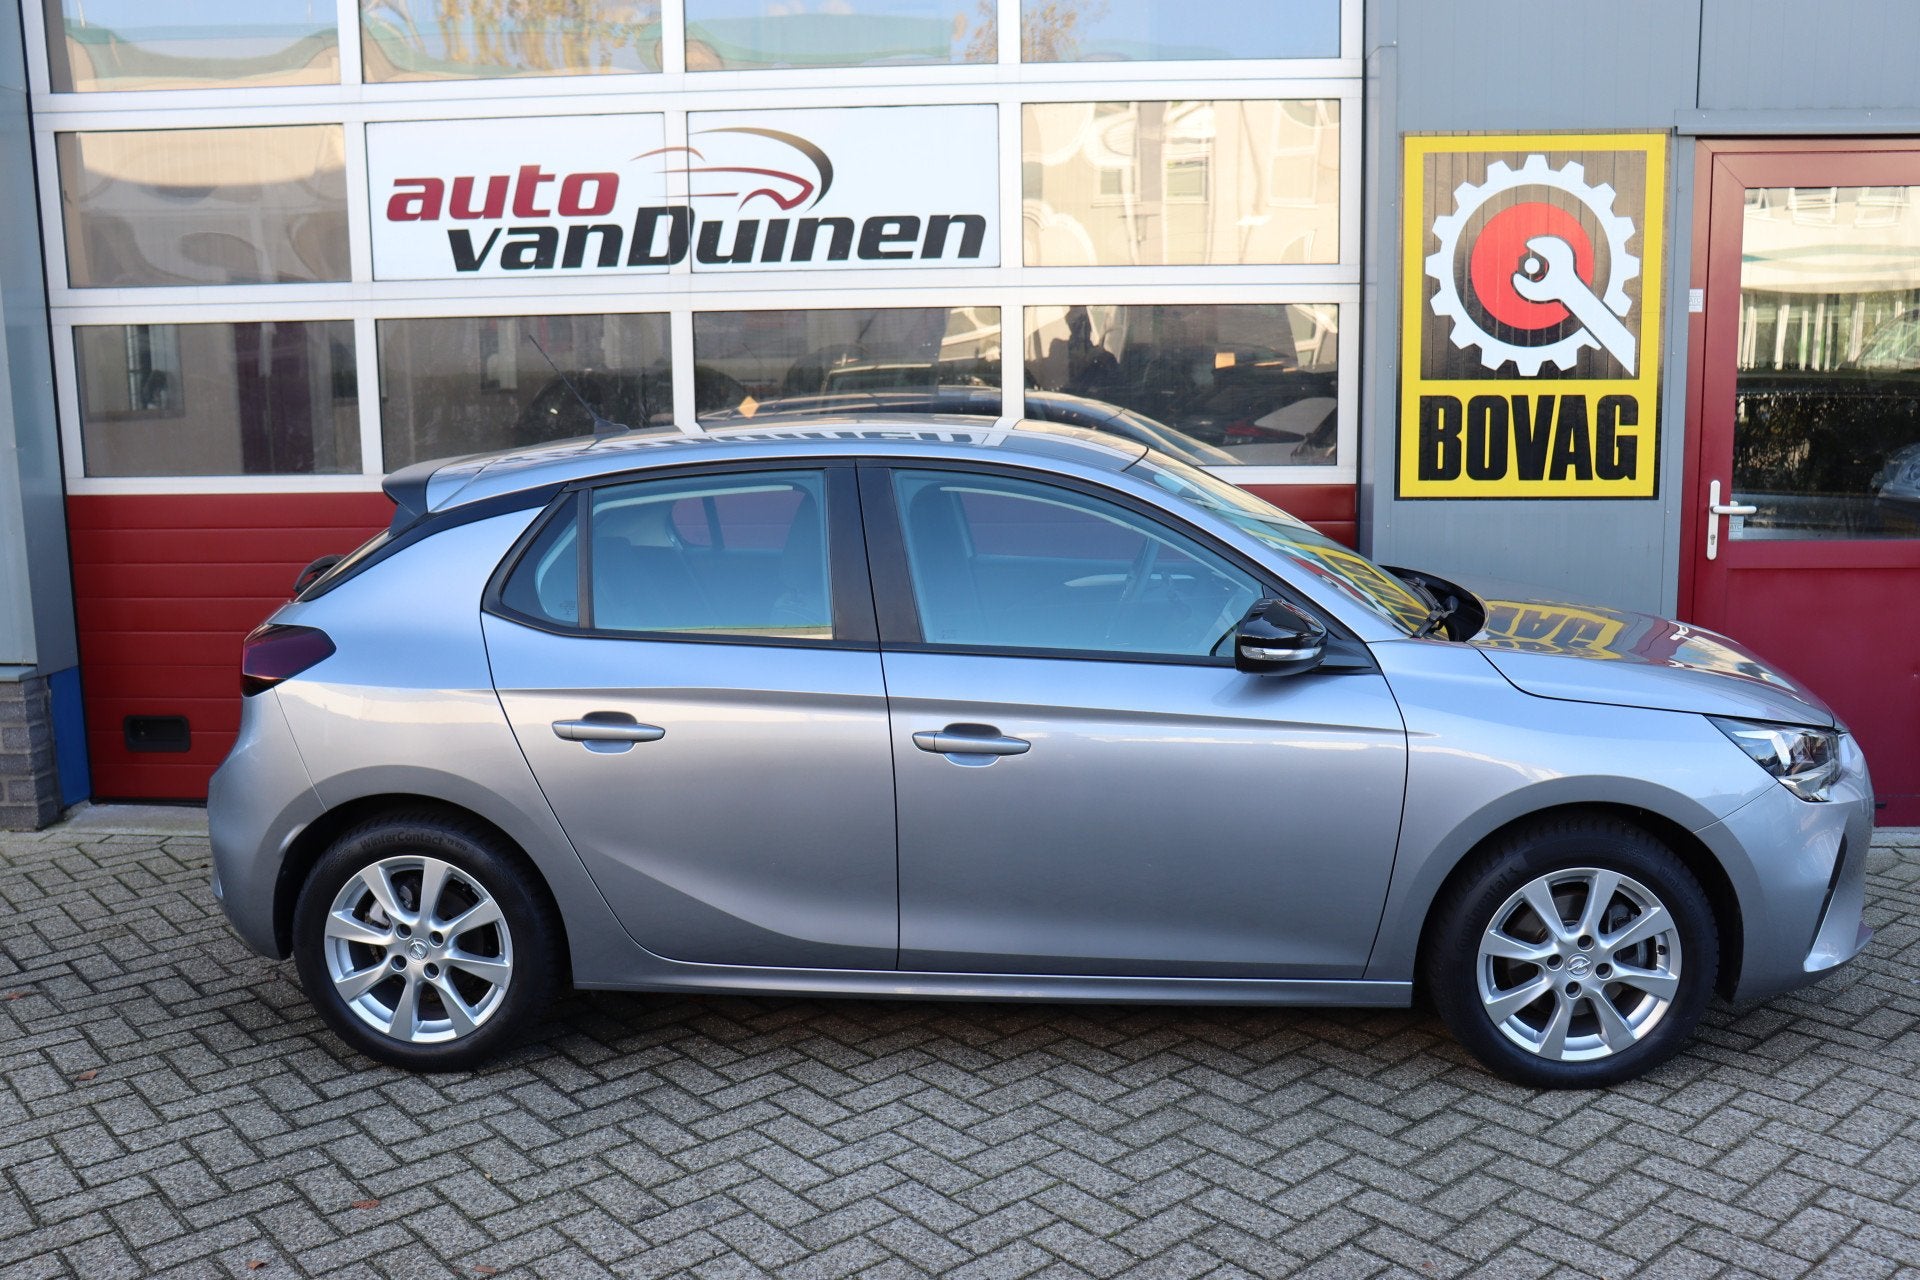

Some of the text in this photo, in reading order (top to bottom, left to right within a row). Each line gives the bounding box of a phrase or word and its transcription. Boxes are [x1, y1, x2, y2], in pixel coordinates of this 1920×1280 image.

[386, 165, 620, 222] auto
[447, 206, 987, 272] vanDuinen
[1418, 394, 1639, 481] BOVAG
